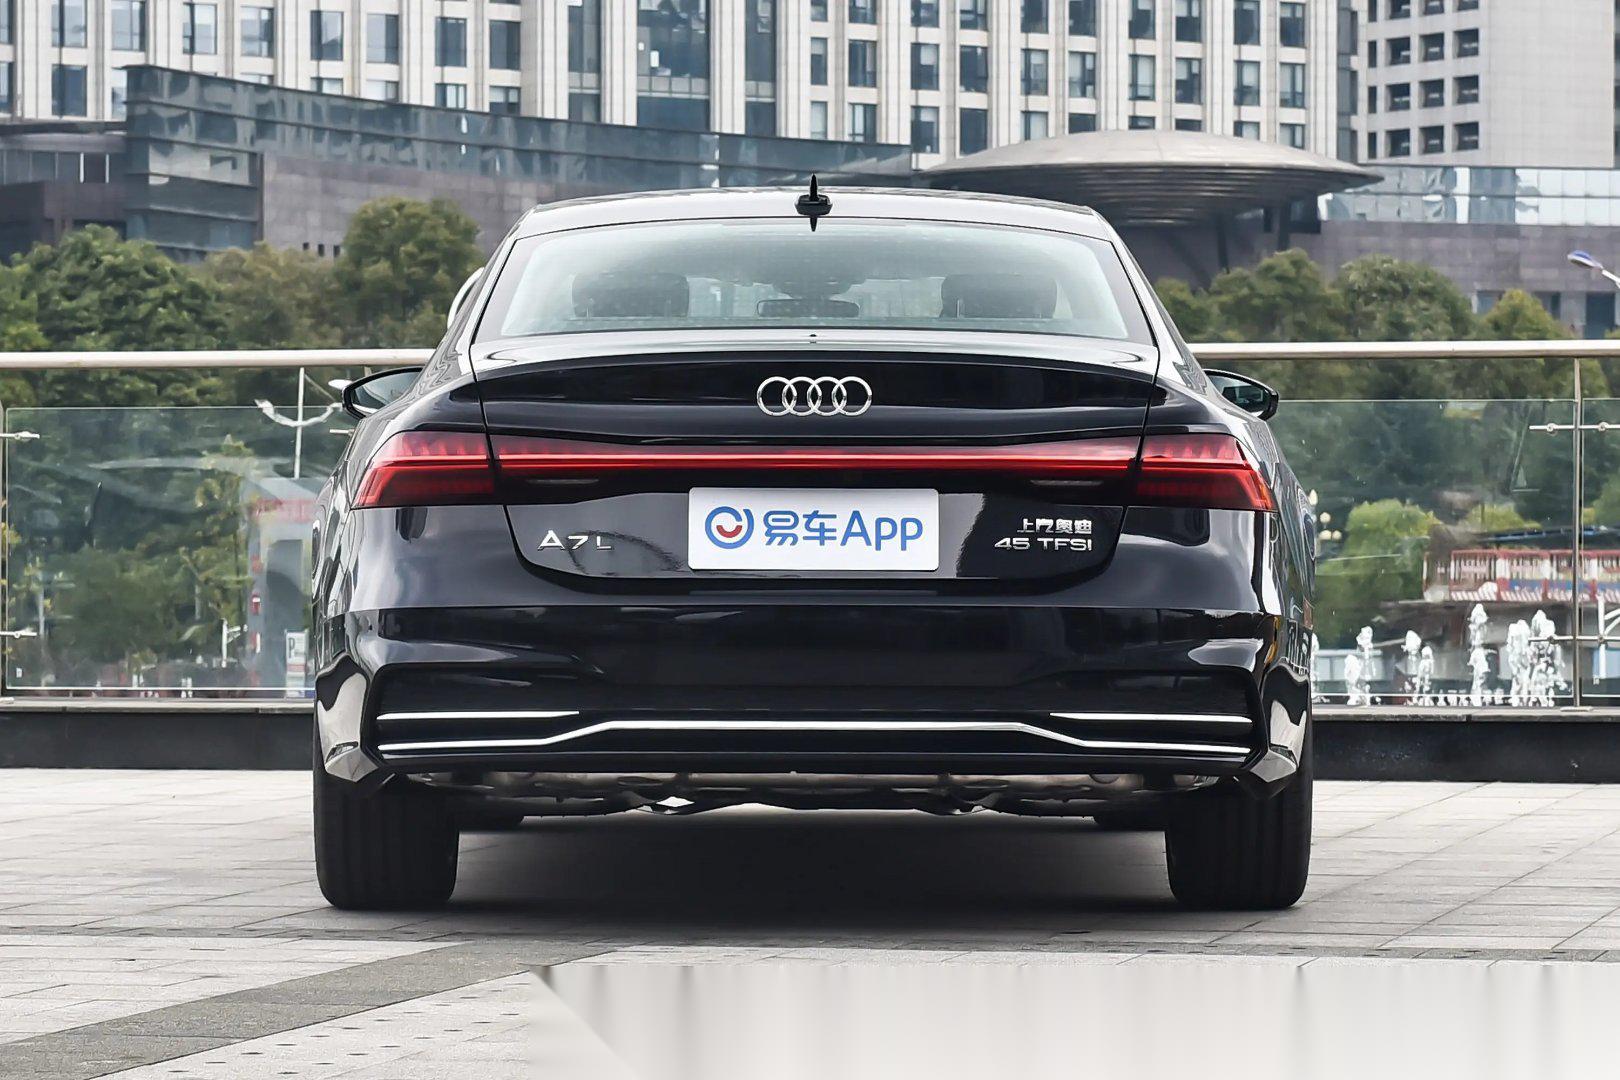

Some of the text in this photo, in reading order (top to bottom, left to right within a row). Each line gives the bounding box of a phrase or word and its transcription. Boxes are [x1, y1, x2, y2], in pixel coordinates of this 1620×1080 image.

[762, 509, 924, 552] 易车App
[994, 537, 1092, 551] 45 TFSI
